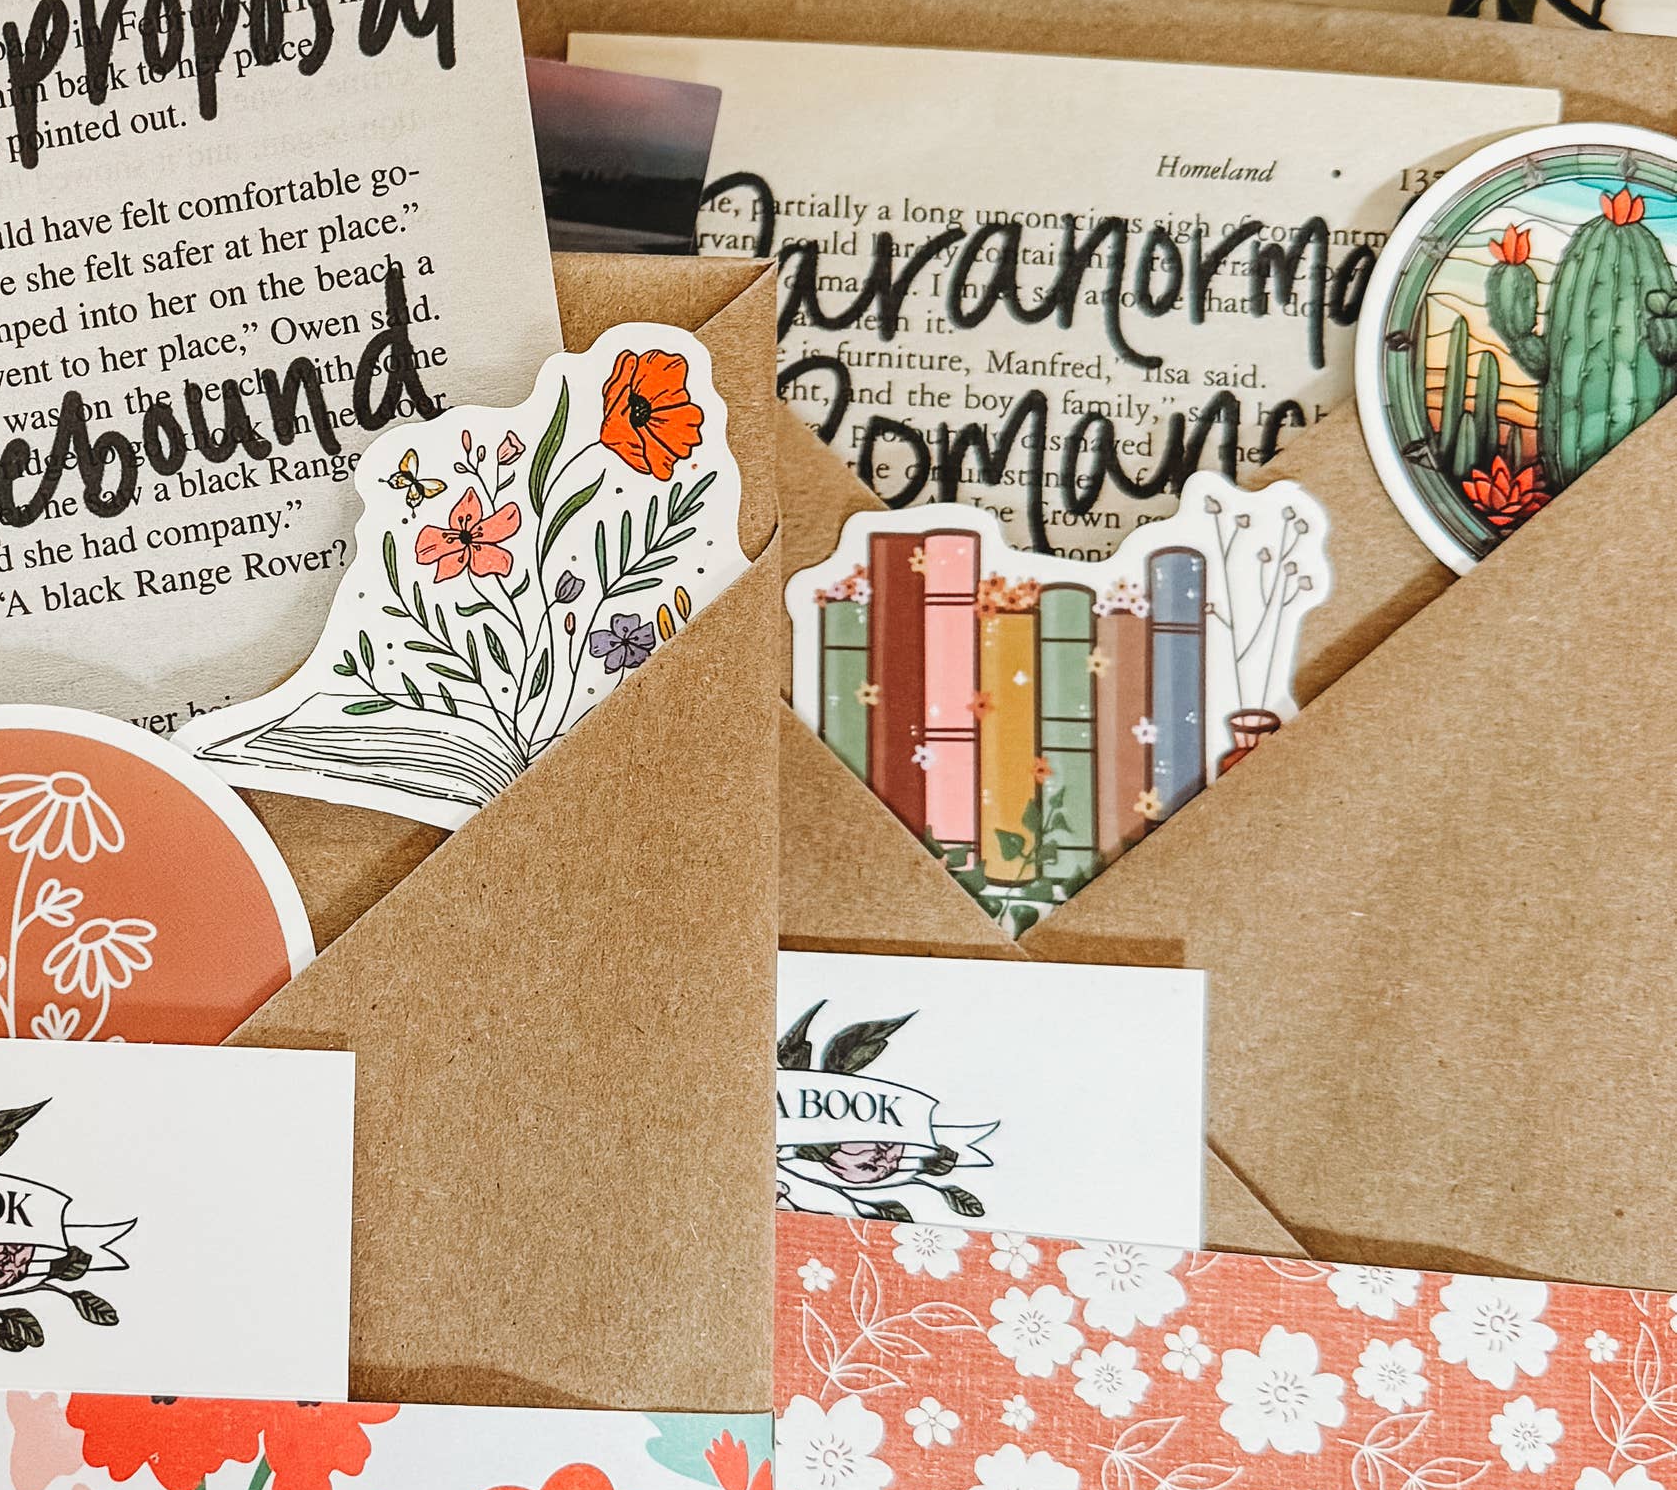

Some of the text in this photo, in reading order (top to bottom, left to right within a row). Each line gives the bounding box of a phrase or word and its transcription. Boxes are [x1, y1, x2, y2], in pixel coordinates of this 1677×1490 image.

[129, 103, 187, 135] out.
[1155, 155, 1277, 184] Homeland
[40, 212, 113, 242] have
[118, 197, 171, 230] felt
[176, 168, 362, 221] comfortable
[370, 166, 420, 199] go-
[877, 198, 964, 230] a long
[24, 259, 76, 291] she
[82, 249, 134, 282] felt
[140, 239, 216, 273] safer
[223, 232, 253, 260] at
[258, 224, 310, 254] her
[316, 202, 419, 253] place.”
[76, 299, 138, 329] into
[147, 288, 199, 318] her
[208, 284, 247, 309] on
[256, 270, 306, 301] the
[415, 254, 435, 276] a
[926, 311, 955, 335] it.
[59, 354, 91, 379] to
[97, 344, 150, 373] her
[156, 322, 259, 371] place,”
[269, 314, 360, 347] Owen
[837, 341, 1267, 390] furniture, said.
[907, 382, 952, 408] the
[152, 481, 171, 502] a
[177, 460, 261, 498] black
[21, 537, 70, 567] she
[80, 524, 137, 558] had
[144, 499, 303, 548] company.”
[41, 574, 130, 612] black
[134, 566, 233, 599] Range
[241, 541, 349, 582] Rover?
[798, 1088, 903, 1127] BOOK
